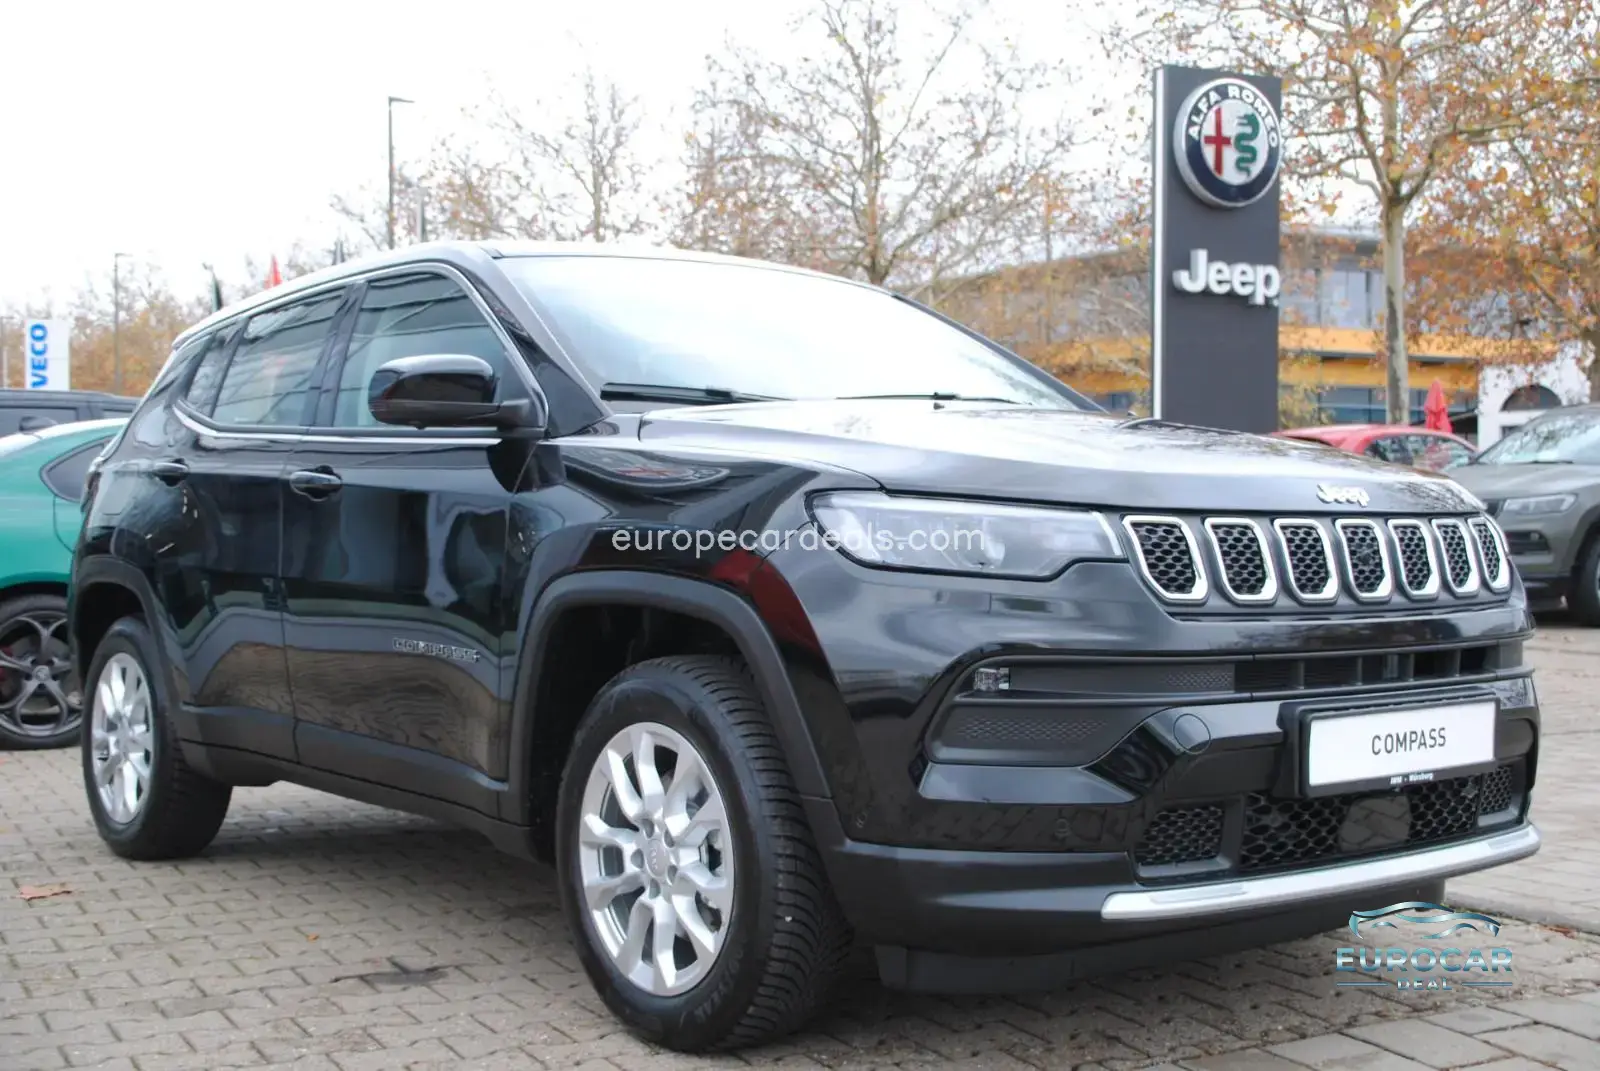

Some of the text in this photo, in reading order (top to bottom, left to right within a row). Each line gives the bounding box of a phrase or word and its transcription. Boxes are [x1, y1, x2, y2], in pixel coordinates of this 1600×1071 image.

[1187, 85, 1279, 148] ALFA ROMEO
[1173, 248, 1280, 306] Jeep
[1316, 482, 1370, 508] Jeep
[1371, 727, 1447, 756] COMPASS
